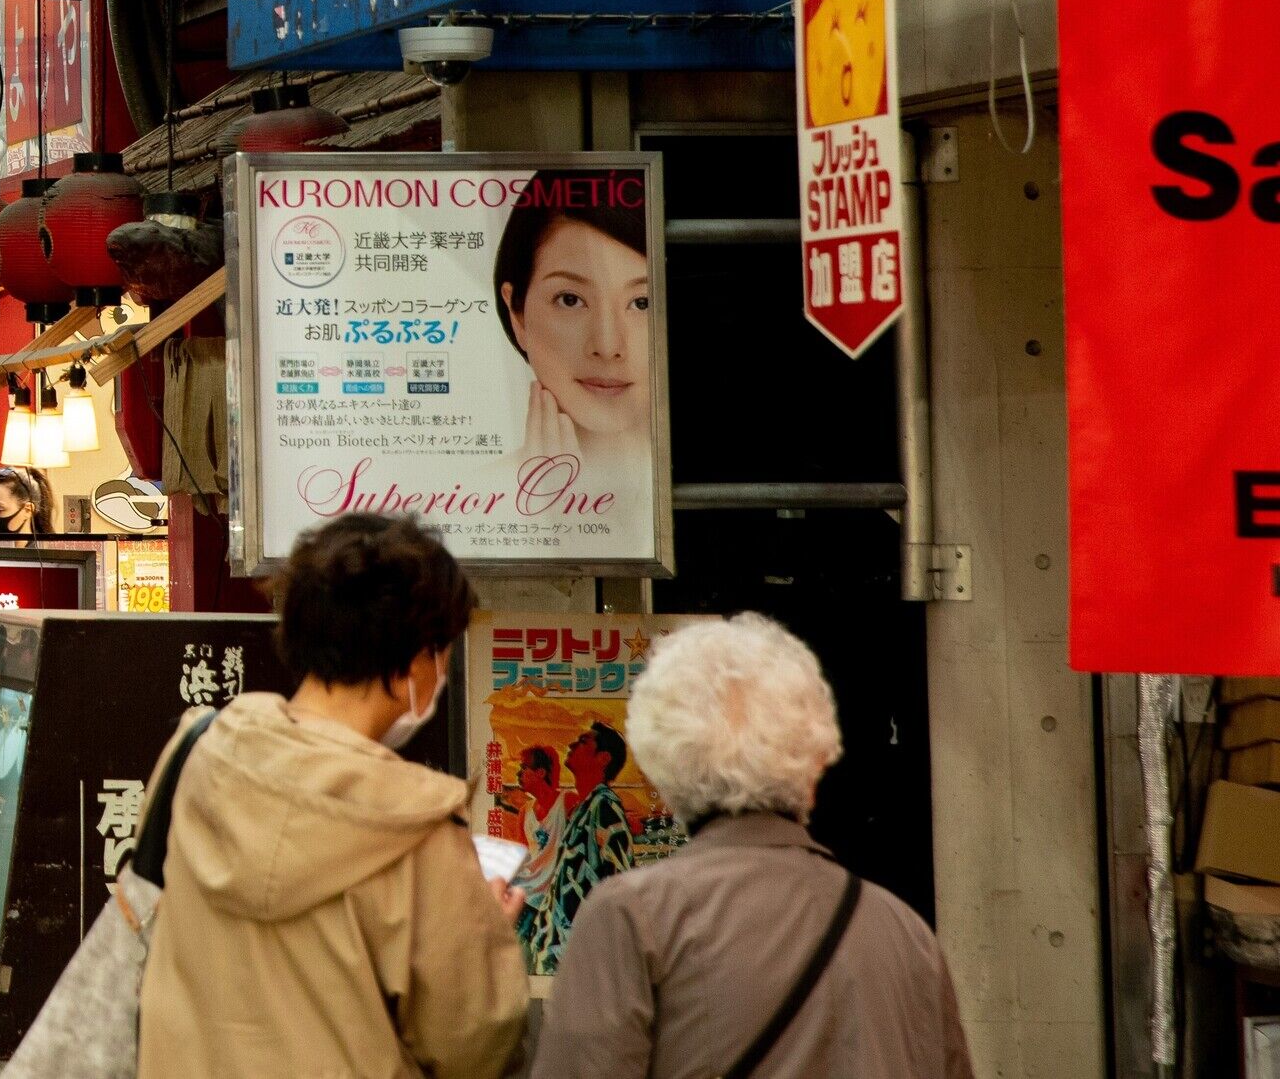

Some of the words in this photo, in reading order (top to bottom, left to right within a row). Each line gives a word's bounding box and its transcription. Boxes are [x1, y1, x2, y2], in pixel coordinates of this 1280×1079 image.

[812, 127, 879, 179] フレッシュ
[258, 178, 439, 209] KUROMON
[808, 170, 892, 232] STAMP
[354, 231, 485, 250] 近畿大学薬学部
[354, 253, 429, 273] 共同開発
[809, 242, 901, 311] 加盟店
[343, 298, 490, 317] スッポンコラーゲンで
[304, 323, 341, 341] お肌
[279, 434, 331, 449] Suppon
[337, 434, 389, 447] Biotech
[516, 453, 616, 518] One
[577, 523, 610, 535] 100%
[492, 628, 623, 662] ニワトリ
